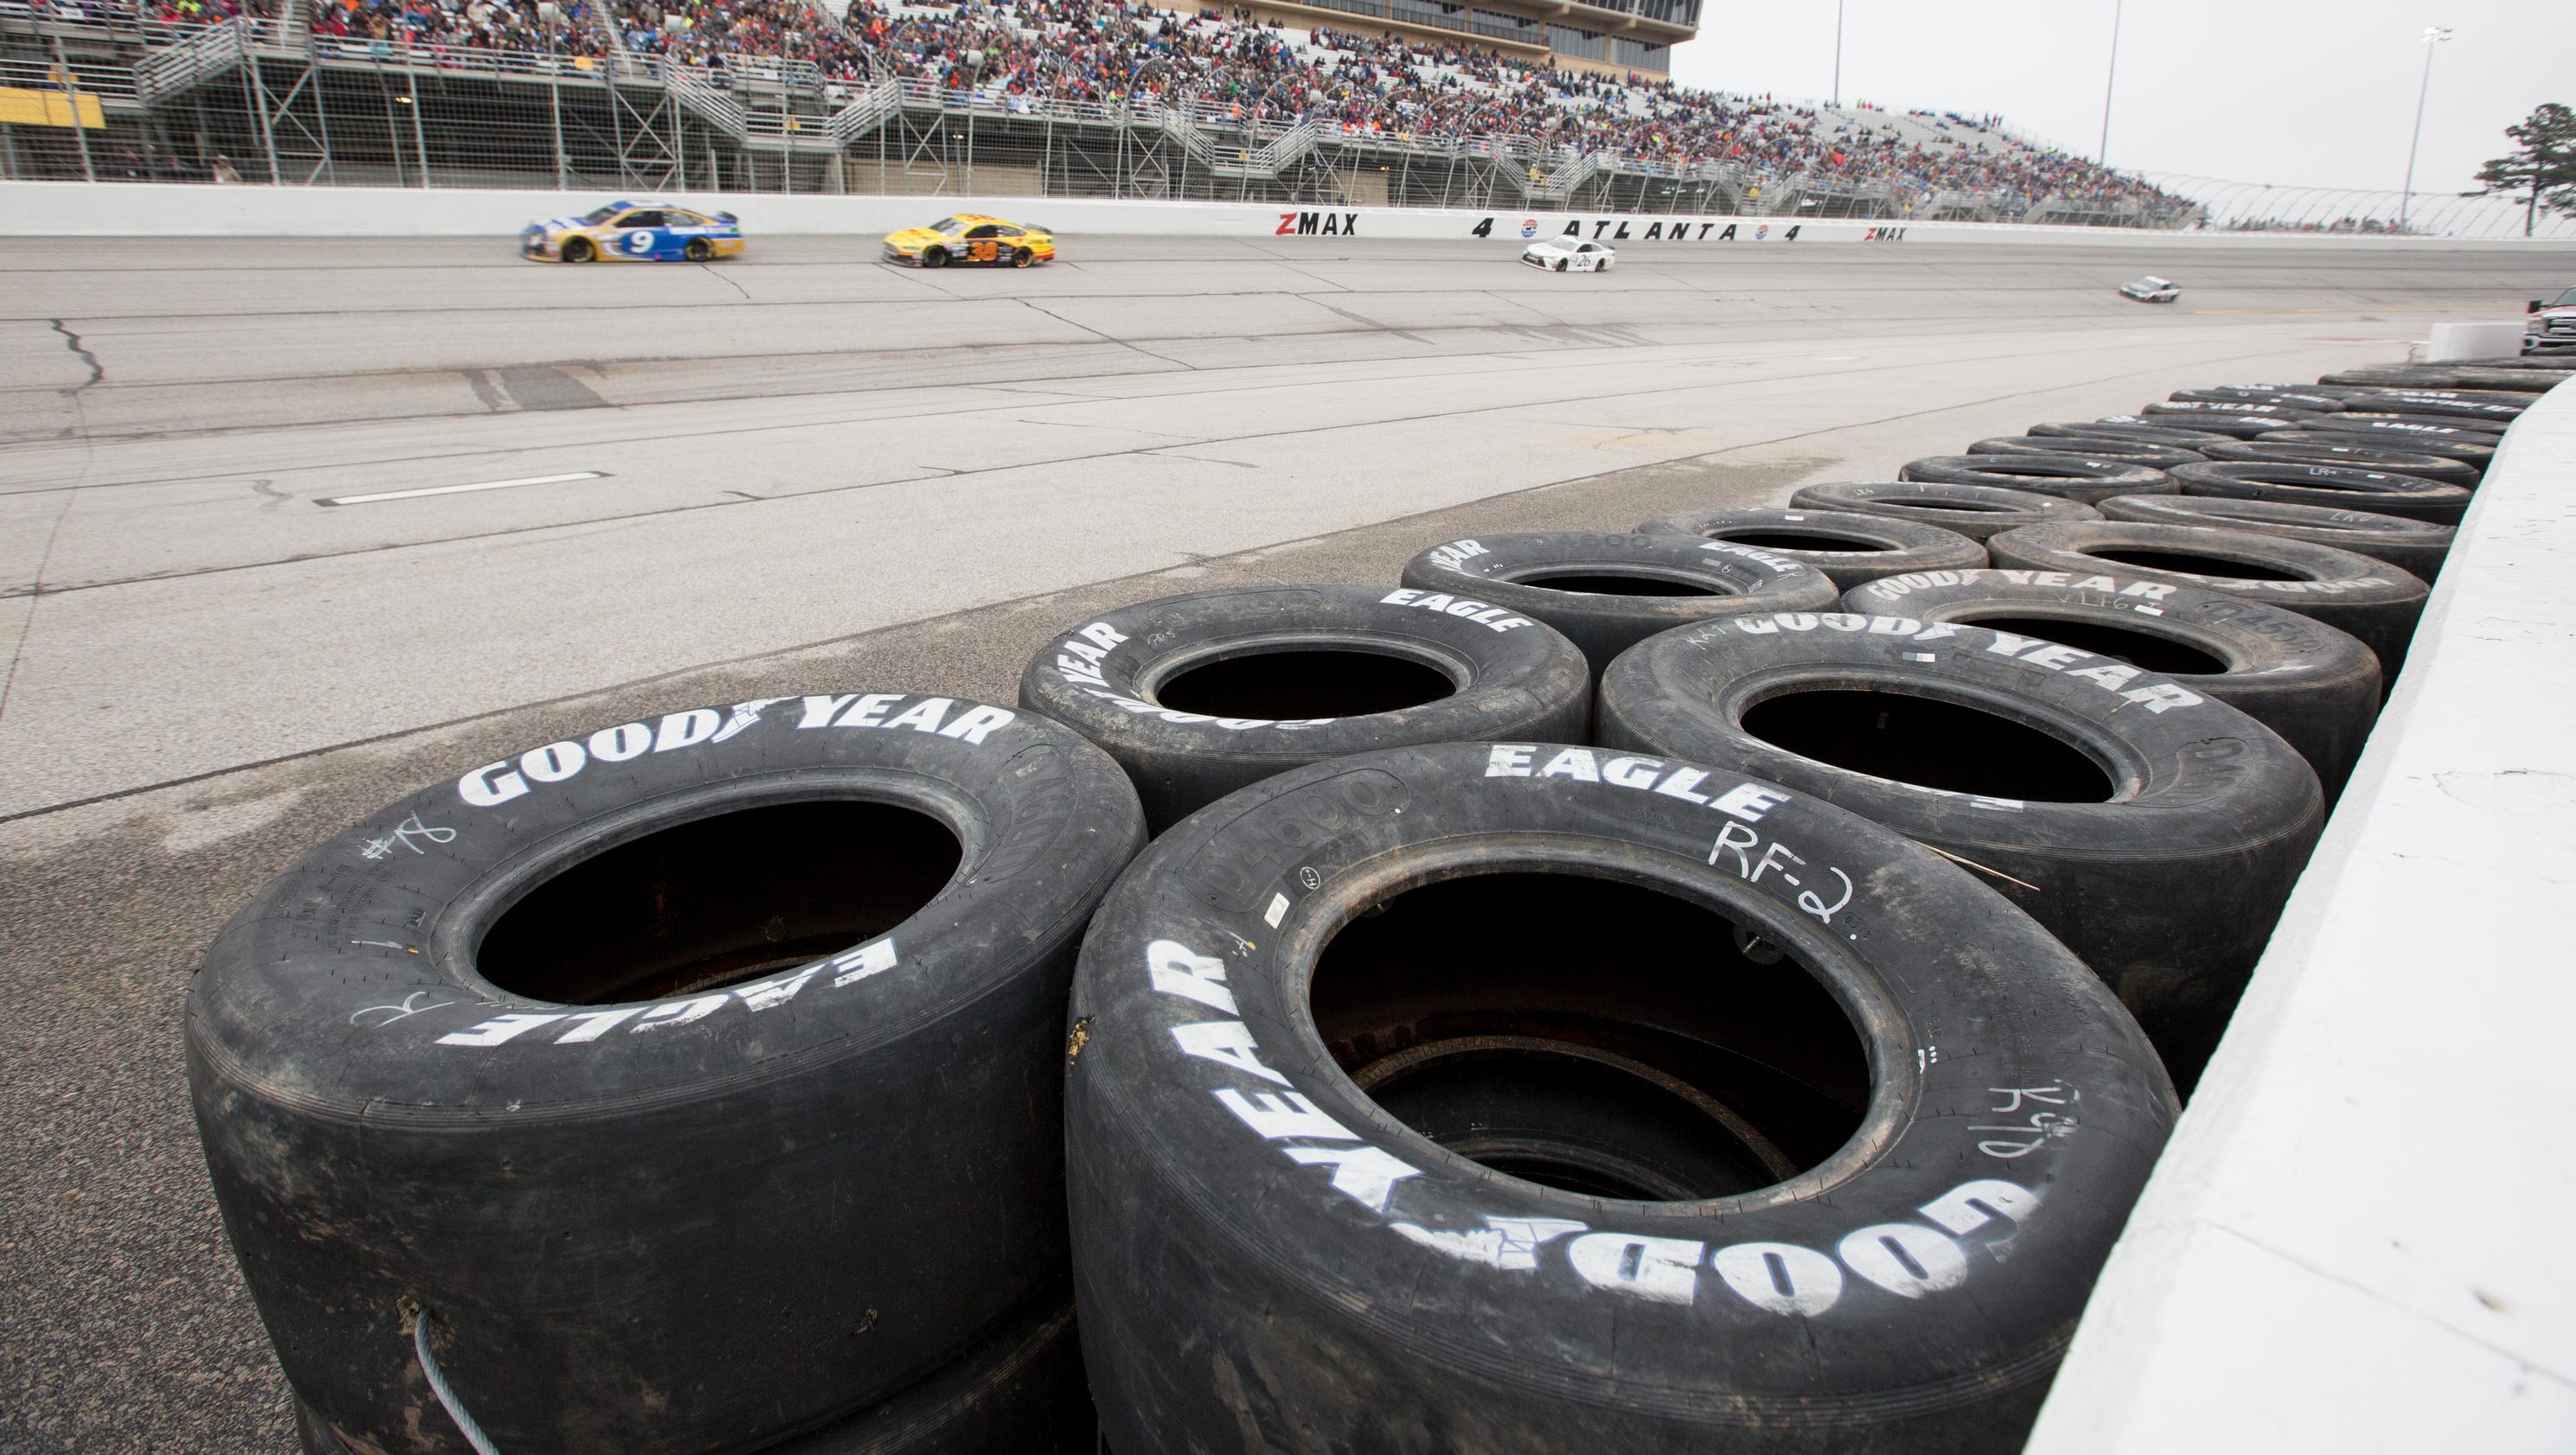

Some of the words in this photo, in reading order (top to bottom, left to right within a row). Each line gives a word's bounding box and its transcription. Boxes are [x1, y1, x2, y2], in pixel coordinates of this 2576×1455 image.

[630, 231, 655, 253] 9
[1472, 218, 1494, 238] 4
[1563, 220, 1736, 239] ATLANTA
[1785, 225, 1801, 240] 4
[1697, 541, 1804, 572] EAGLE
[1866, 571, 1959, 602] GOOD
[1993, 569, 2178, 601] YEAR
[1381, 588, 1536, 633] EAGLE
[1058, 622, 1130, 687] YEAR
[1735, 613, 1922, 635] GOOD
[1986, 630, 2204, 715] YEAR
[458, 708, 721, 807] GOOD
[796, 694, 1015, 745] YEAR
[1485, 744, 1792, 822] EAGLE
[1708, 820, 1853, 923] RF-2
[433, 937, 898, 1047] EAGLE
[1147, 939, 1425, 1216] YEAR
[1567, 1179, 2043, 1318] GOOD
